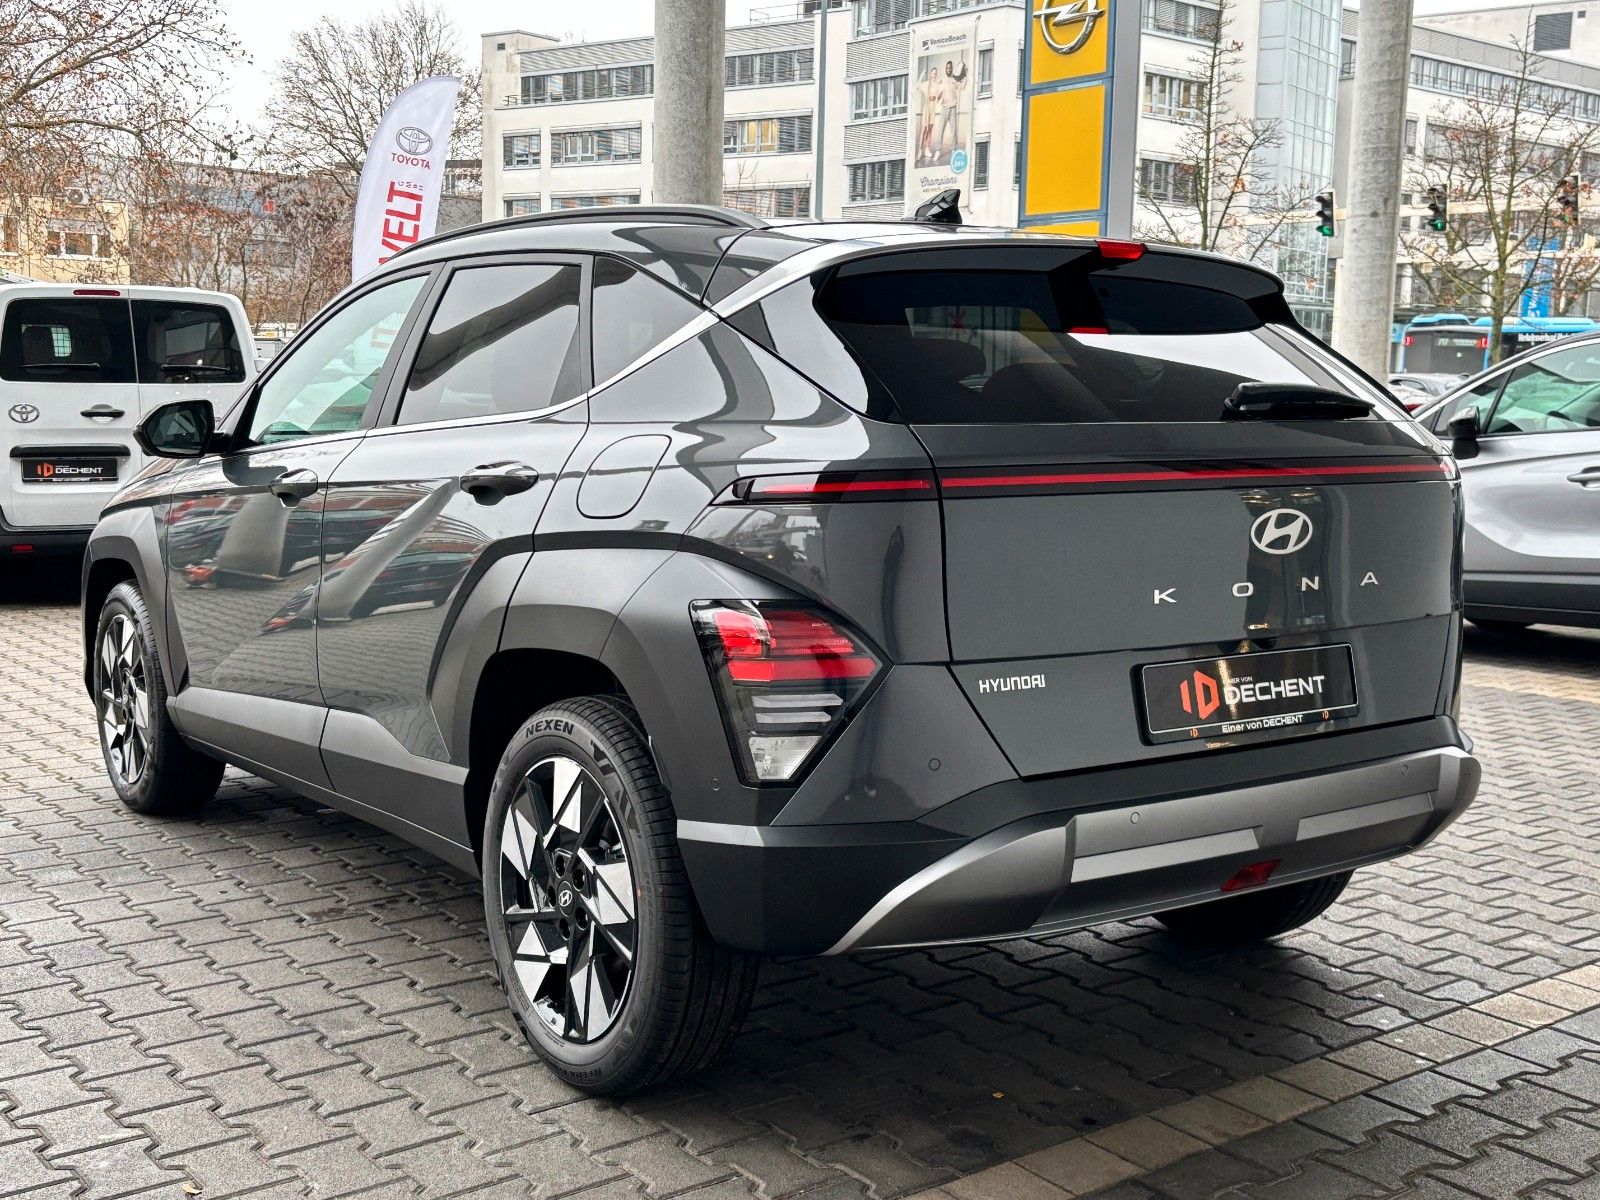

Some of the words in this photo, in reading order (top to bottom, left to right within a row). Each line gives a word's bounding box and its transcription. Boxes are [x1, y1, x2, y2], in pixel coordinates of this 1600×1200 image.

[391, 153, 431, 169] TOYOTA
[978, 674, 1046, 693] HYUNDAI
[1223, 675, 1325, 705] DECHENT
[525, 719, 574, 739] NEXEN
[1221, 723, 1244, 734] Einer
[1246, 721, 1263, 730] von
[1263, 714, 1303, 728] DECHENT
